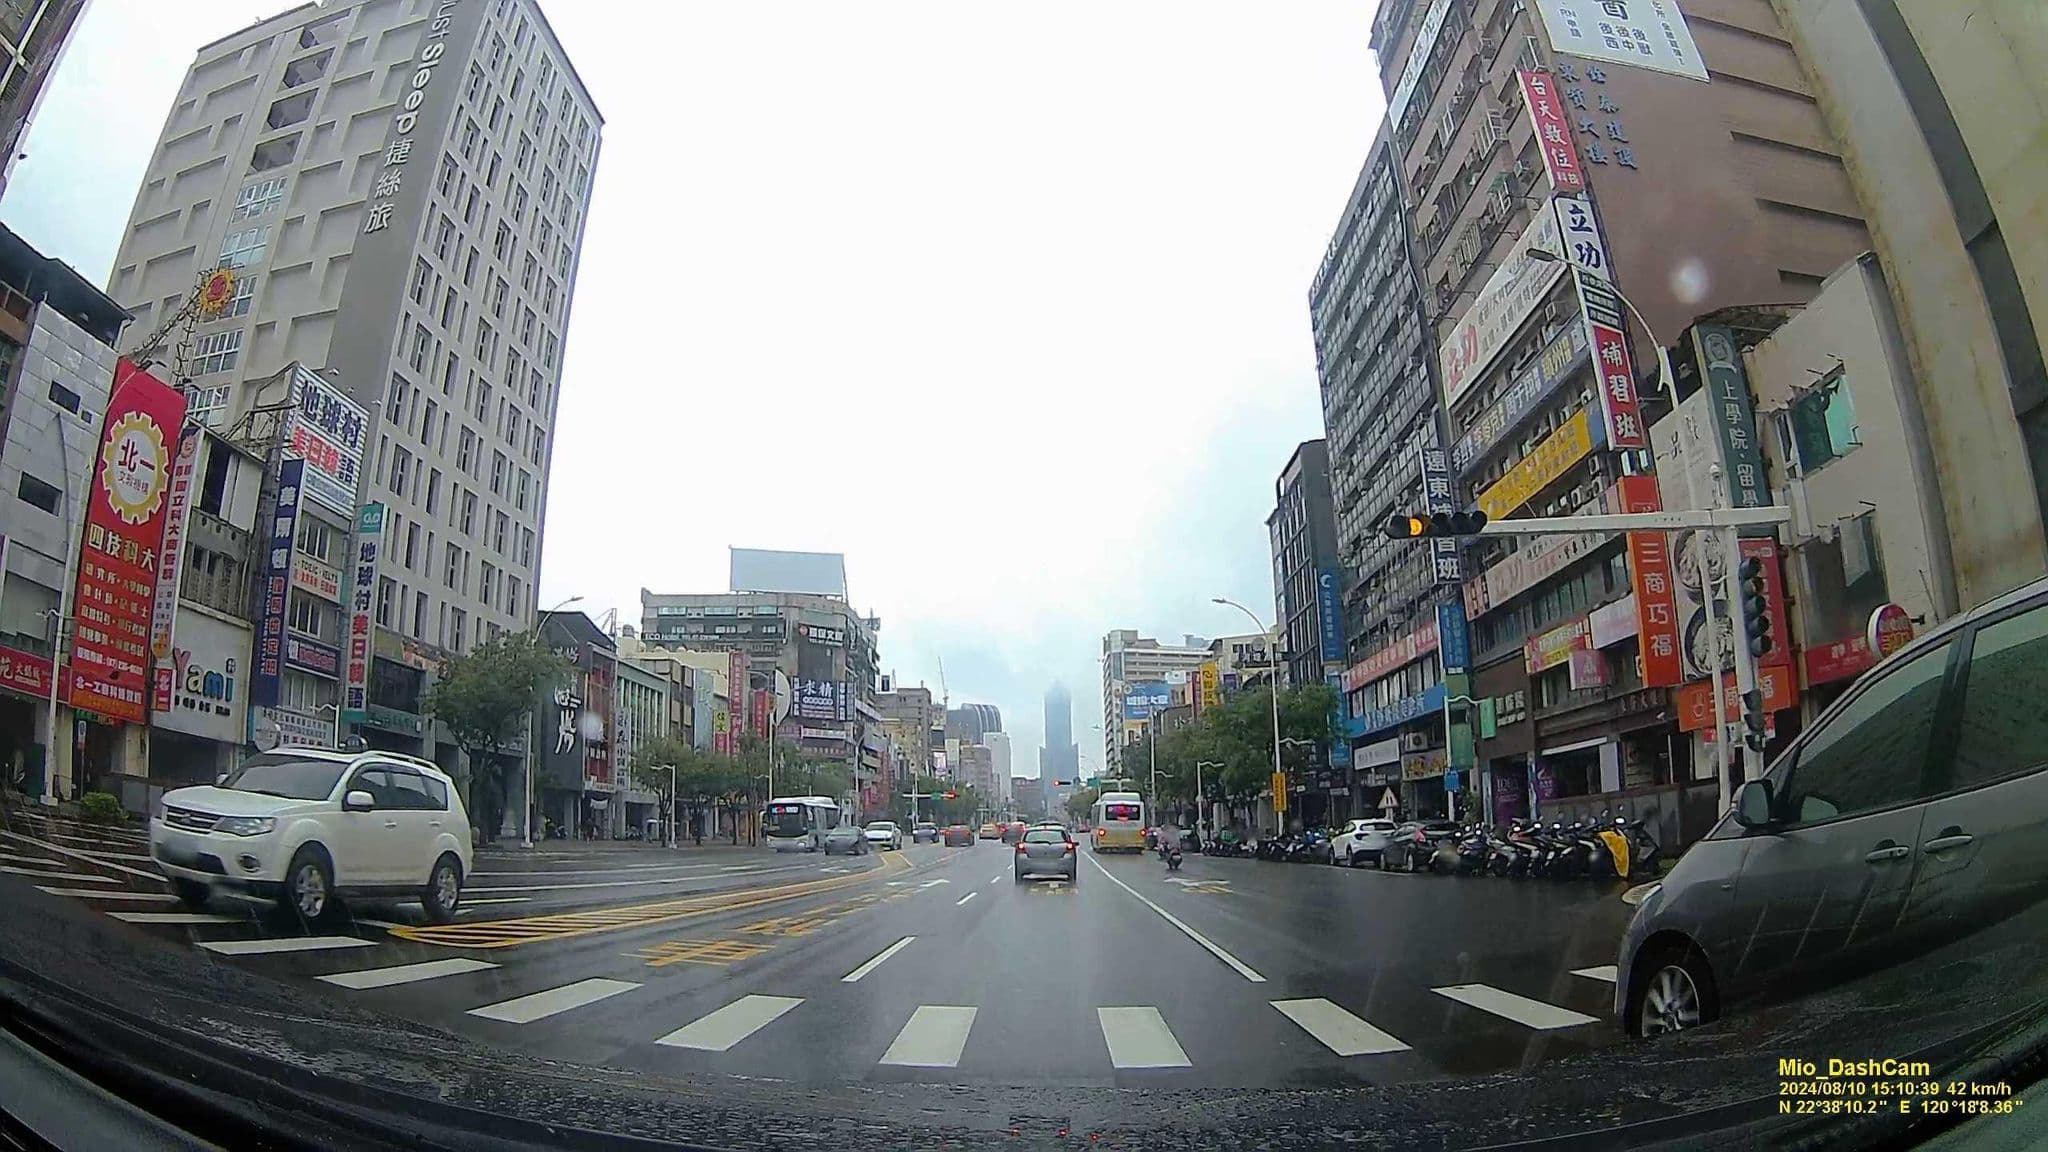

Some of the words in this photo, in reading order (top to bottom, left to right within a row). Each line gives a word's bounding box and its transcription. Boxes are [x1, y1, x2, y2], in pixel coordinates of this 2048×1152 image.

[428, 0, 457, 39] ust
[396, 42, 445, 135] Sleep
[363, 138, 414, 234] 捷絲旅
[1568, 203, 1601, 269] 立功
[1601, 341, 1639, 438] 補習班
[118, 438, 156, 473] 北一
[88, 522, 156, 573] 四技科大
[1640, 542, 1673, 657] 三商巧福
[173, 647, 235, 702] Yami
